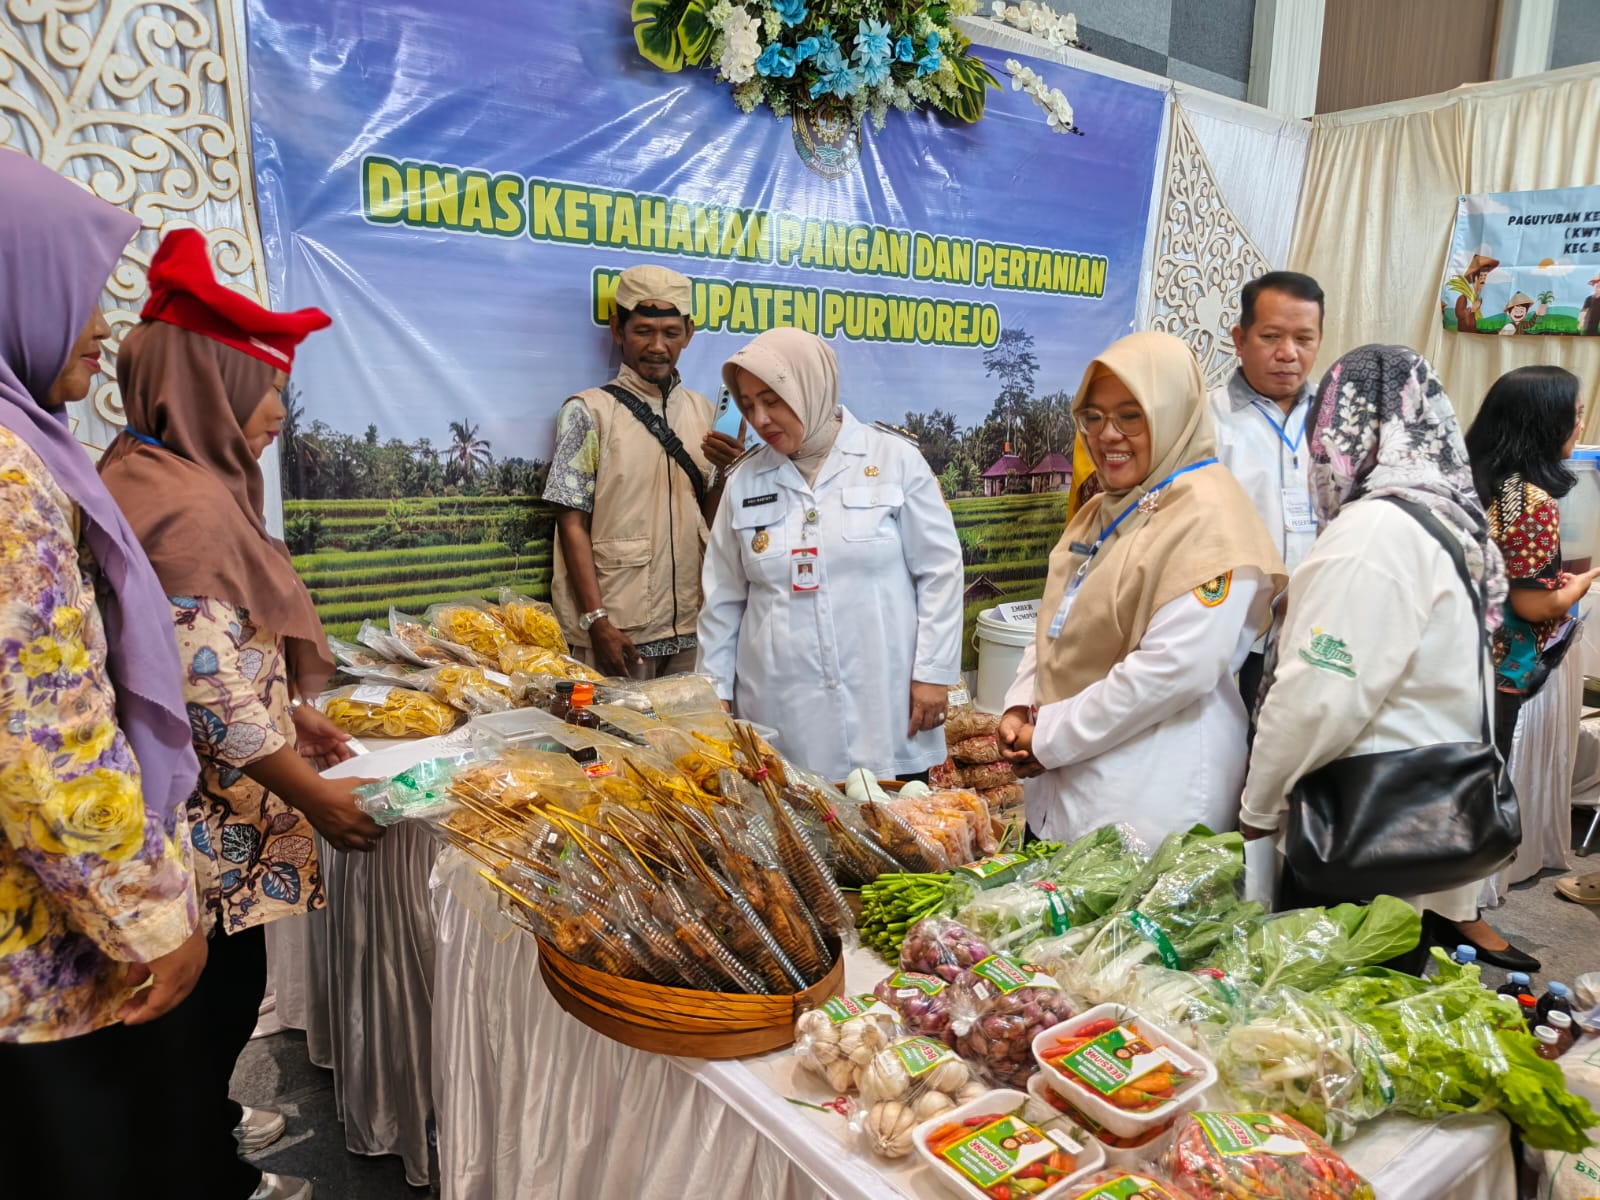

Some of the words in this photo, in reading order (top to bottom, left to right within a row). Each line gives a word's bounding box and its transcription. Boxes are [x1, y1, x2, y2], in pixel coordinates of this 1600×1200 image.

[362, 156, 526, 236] DINAS
[531, 180, 773, 263] KETAHANAN
[778, 218, 911, 278] PANGAN
[914, 232, 973, 285] DAN
[975, 242, 1107, 298] PERTANIAN
[1507, 212, 1580, 225] PAGUYUBAN
[1563, 243, 1589, 254] KEC.
[593, 268, 819, 334] KUPATEN
[822, 289, 999, 346] PURWOREJO
